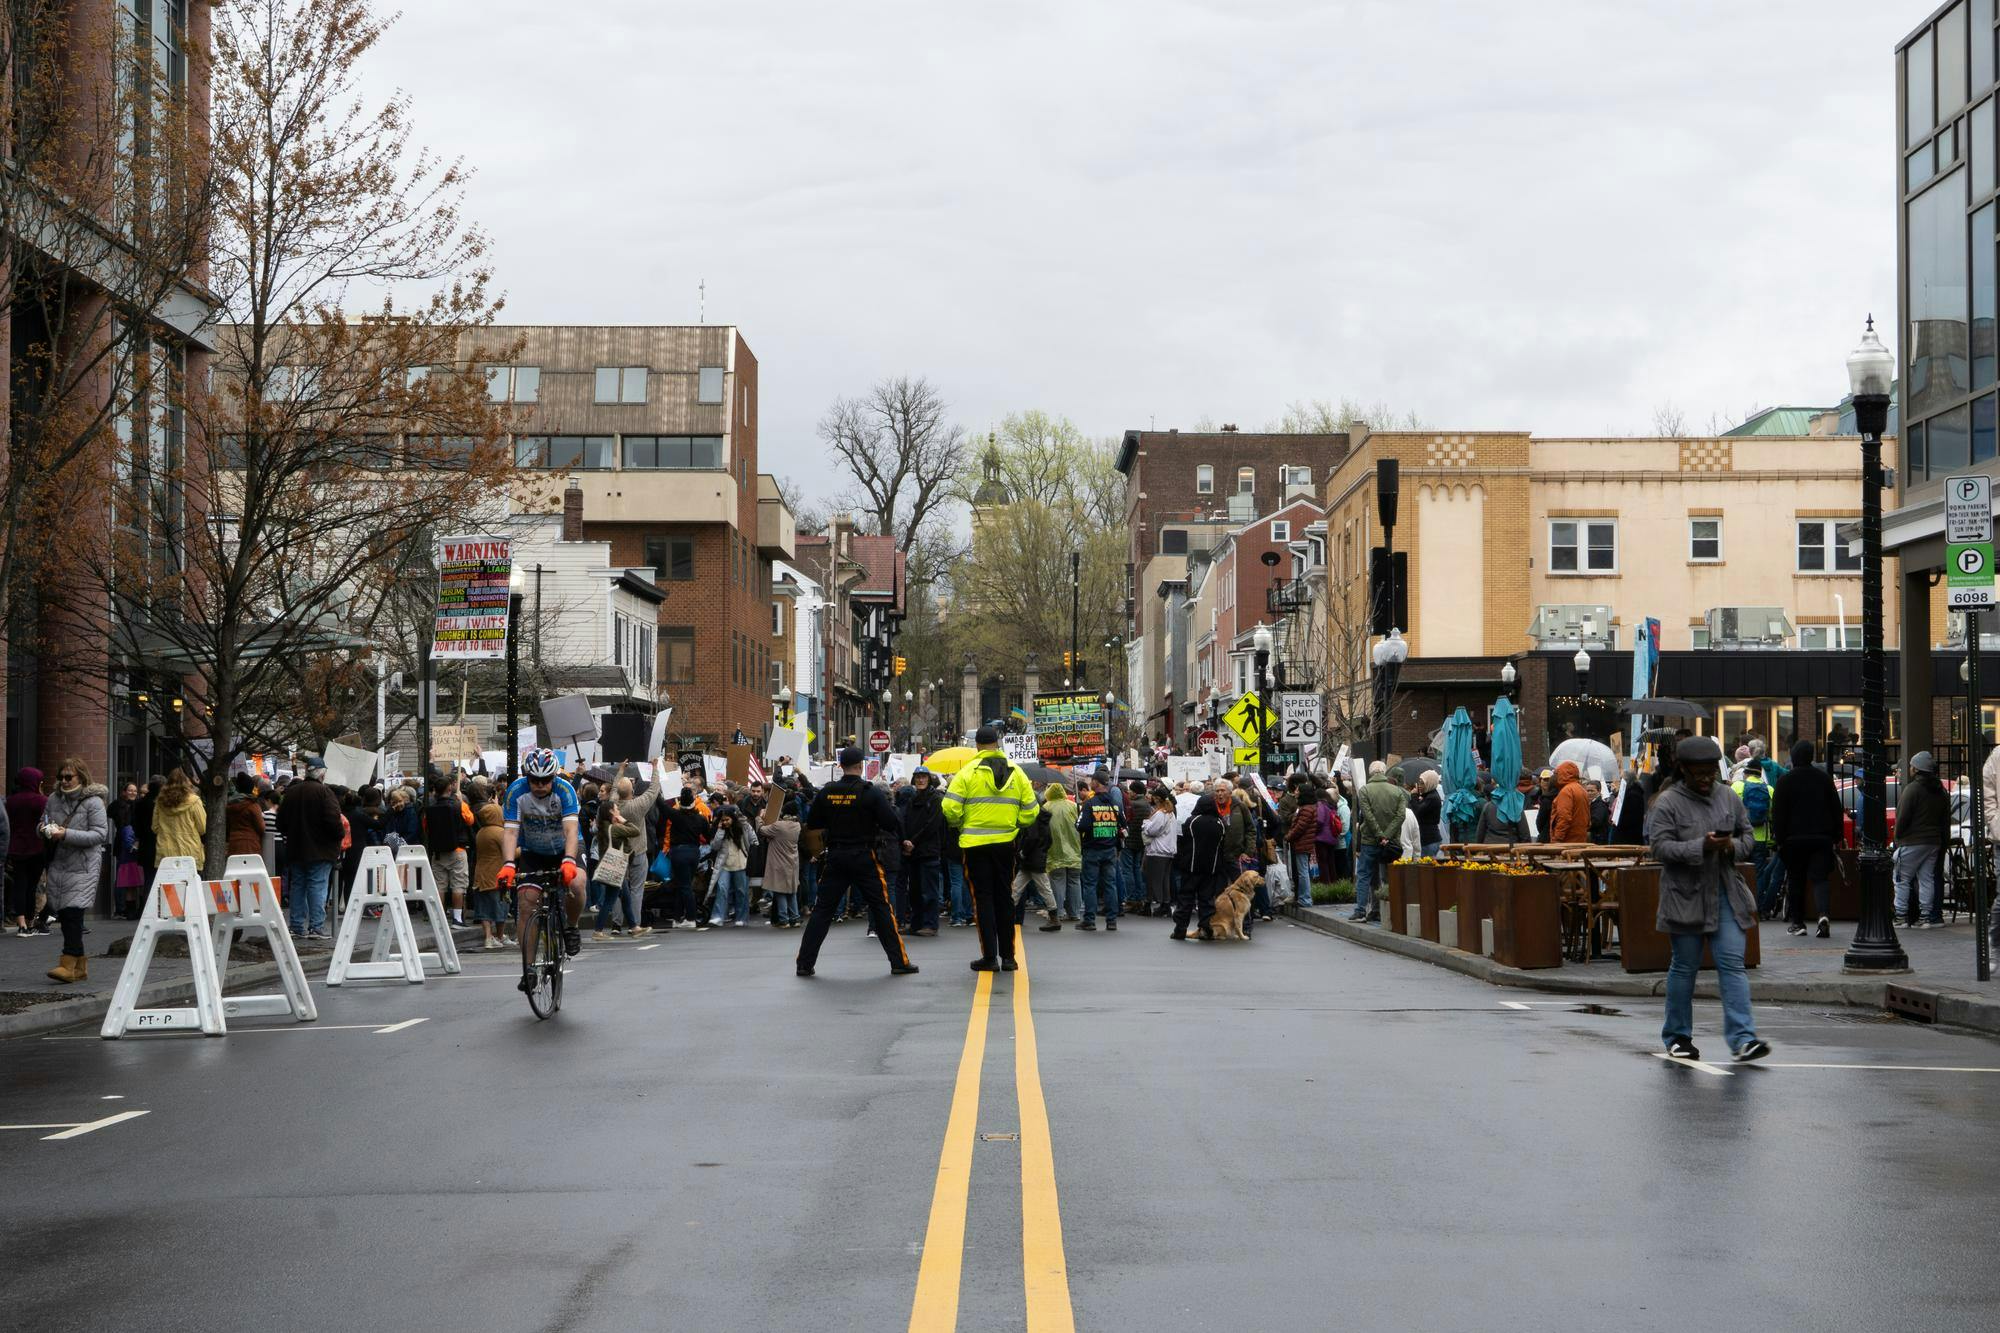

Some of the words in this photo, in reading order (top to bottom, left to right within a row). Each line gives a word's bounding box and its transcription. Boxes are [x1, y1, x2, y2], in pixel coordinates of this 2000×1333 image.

[1964, 483, 1974, 498] P
[444, 542, 510, 561] WARNING
[1965, 554, 1978, 570] P
[1955, 593, 1988, 603] 6098
[437, 618, 460, 629] HELL
[466, 616, 505, 628] AWAITS
[437, 630, 469, 640] JUDGMENT
[470, 630, 477, 639] IS
[479, 629, 504, 639] COMING
[435, 642, 456, 651] DON'T
[458, 642, 466, 650] GO
[470, 641, 478, 650] TO
[482, 640, 503, 650] HELL!!
[1075, 695, 1099, 703] OBEY
[1035, 703, 1100, 716] JESUS
[1035, 713, 1101, 724] REPENT
[1036, 725, 1055, 734] SIN
[1057, 724, 1073, 732] NO
[1286, 720, 1317, 737] 20
[1039, 734, 1064, 746] LAKE
[1067, 734, 1079, 744] OF
[1083, 733, 1103, 743] FIRE
[1009, 751, 1036, 759] SPEECH
[1038, 748, 1054, 758] FOR
[1056, 747, 1071, 756] ALL
